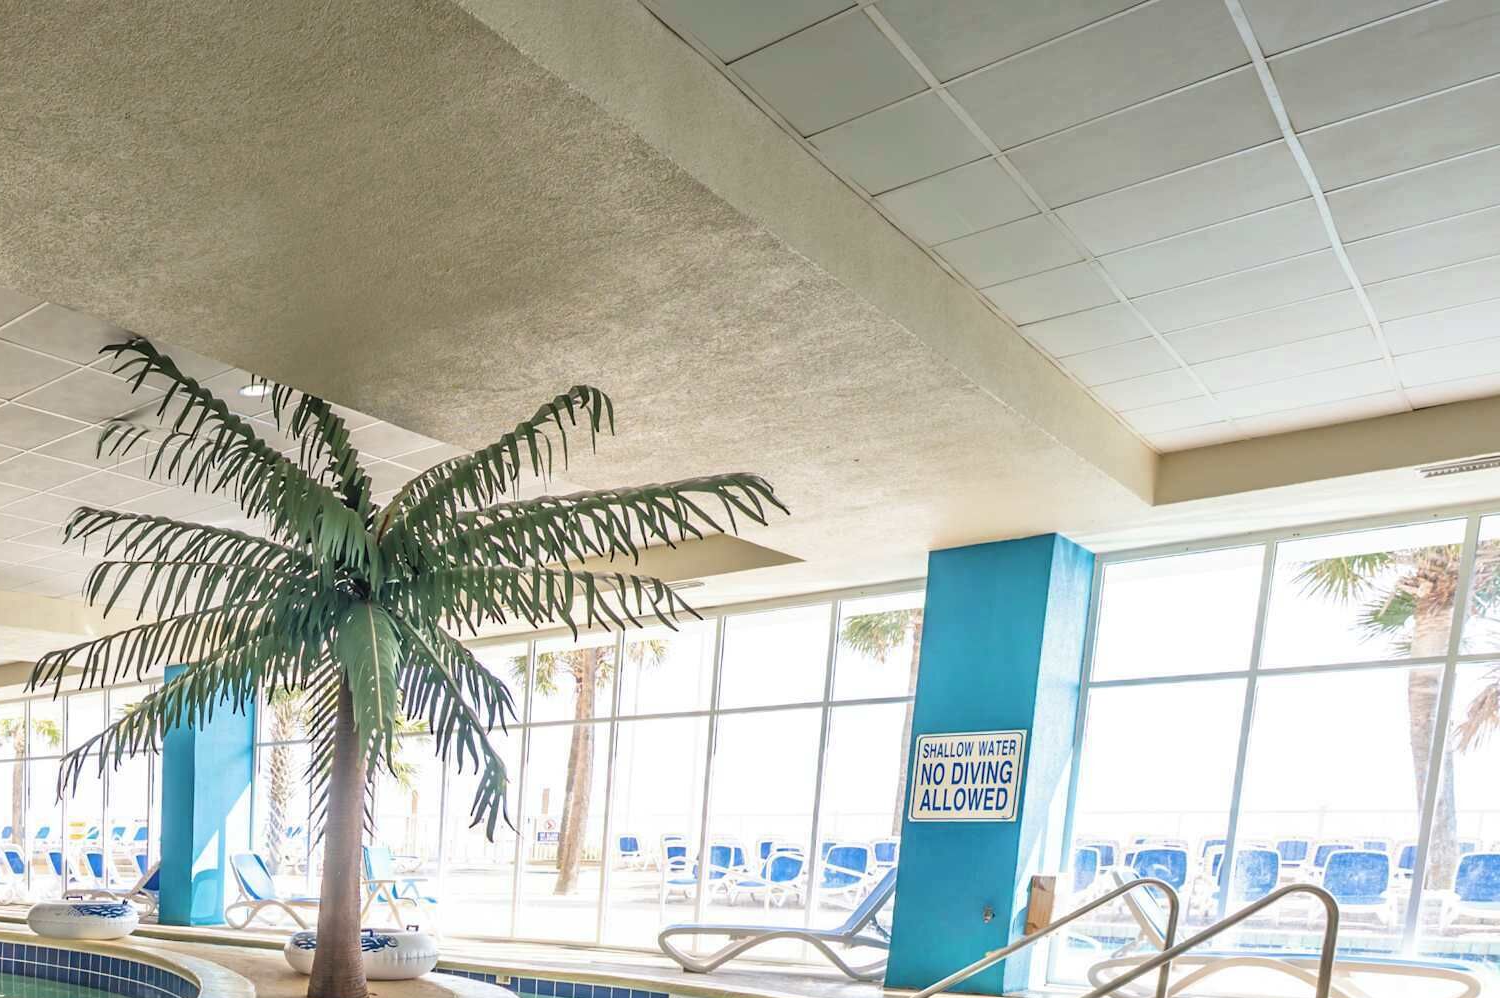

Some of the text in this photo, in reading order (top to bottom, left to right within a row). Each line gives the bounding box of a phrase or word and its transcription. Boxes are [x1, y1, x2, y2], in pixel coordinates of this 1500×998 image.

[923, 740, 1017, 758] SHALLOW WATER
[920, 760, 1013, 785] NO DIVING
[919, 788, 1008, 811] ALLOWED
